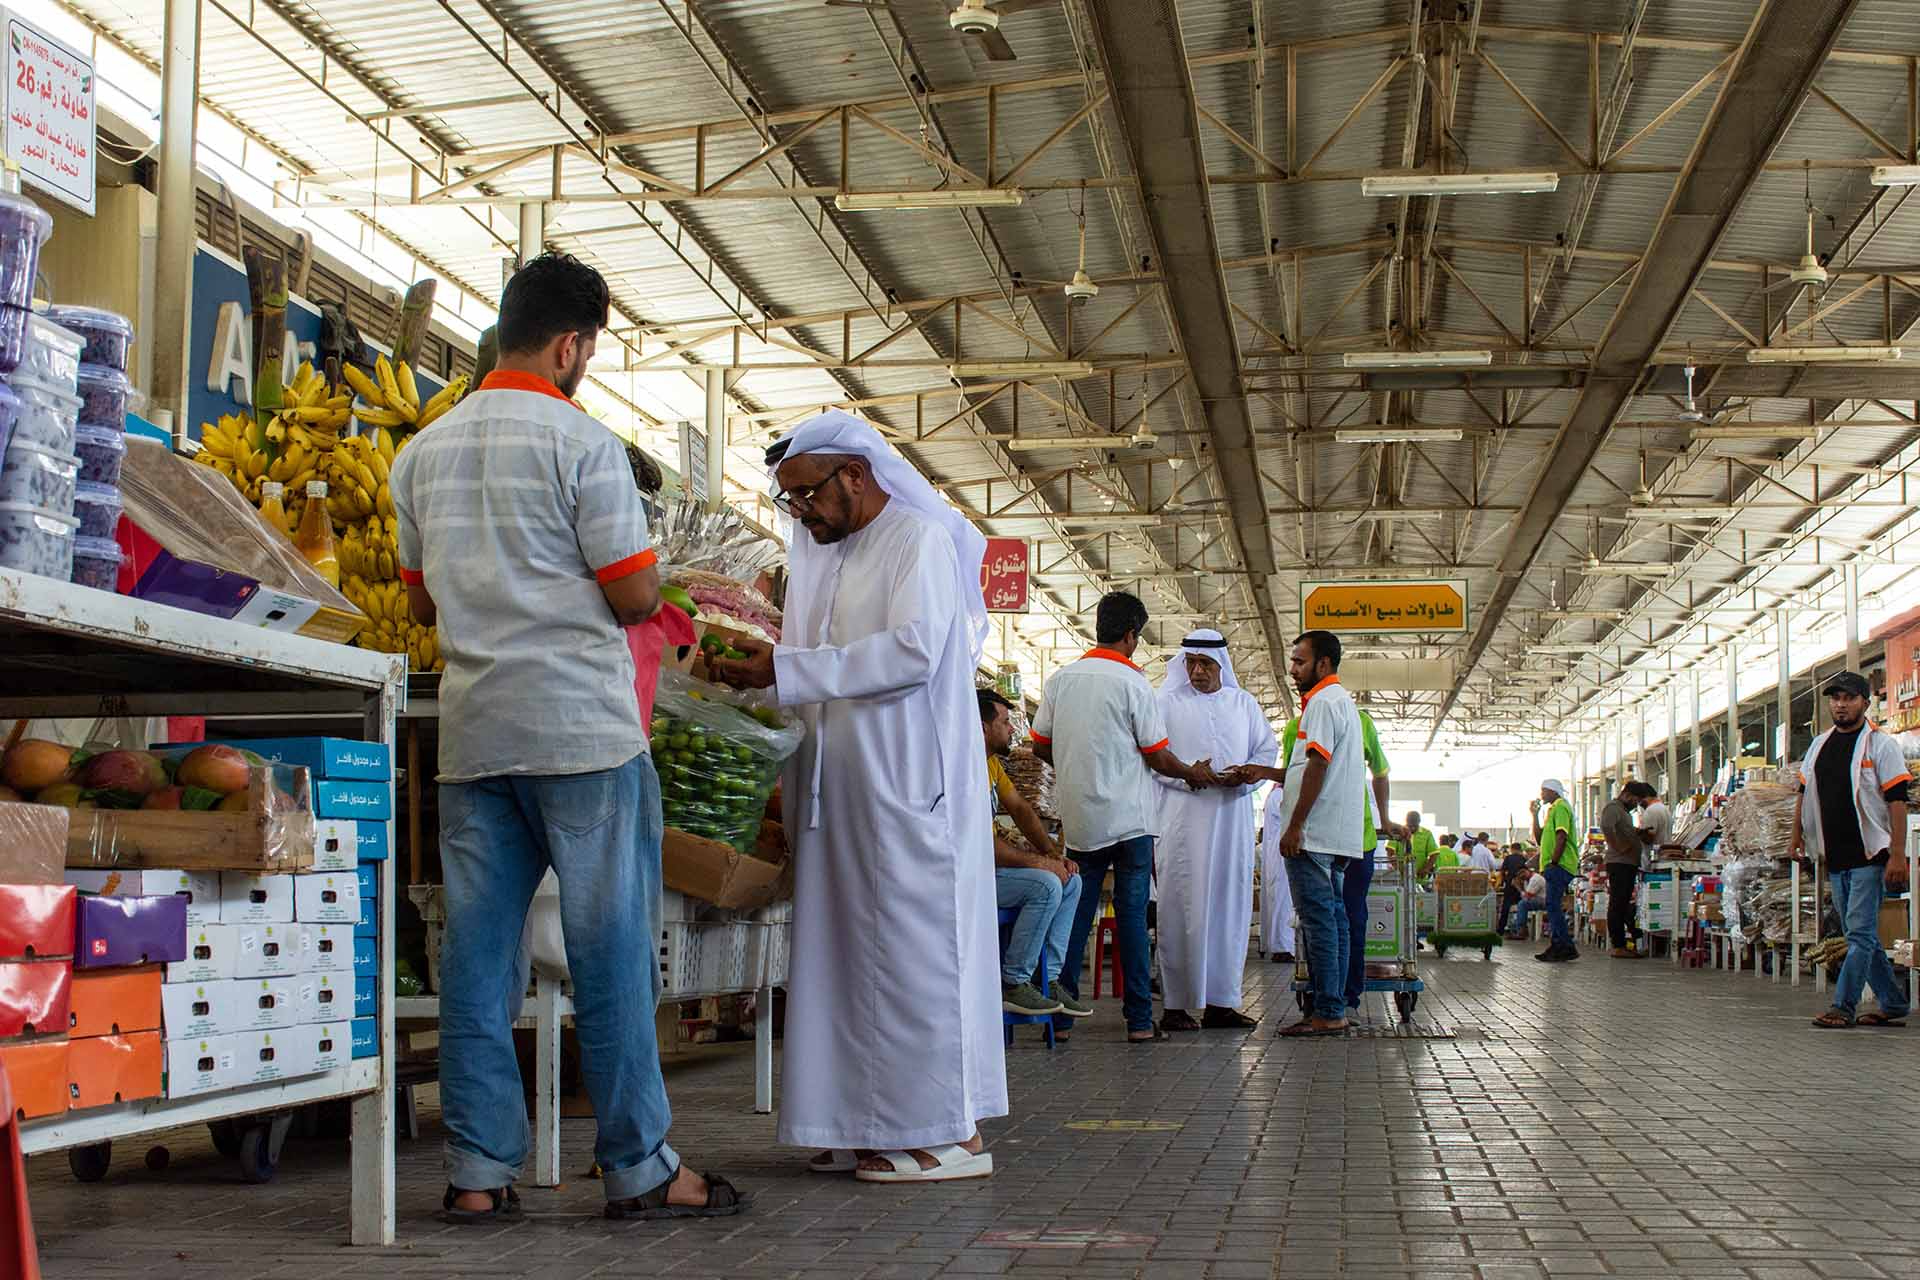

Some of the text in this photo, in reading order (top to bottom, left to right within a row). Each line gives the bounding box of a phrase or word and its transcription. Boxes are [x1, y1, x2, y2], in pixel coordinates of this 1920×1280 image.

[16, 59, 35, 95] 26
[60, 84, 89, 120] طاولة
[22, 143, 48, 162] التمور
[65, 132, 87, 158] طاولة
[992, 580, 1018, 608] شوي
[1313, 600, 1455, 621] طاولات بيع الأسماك
